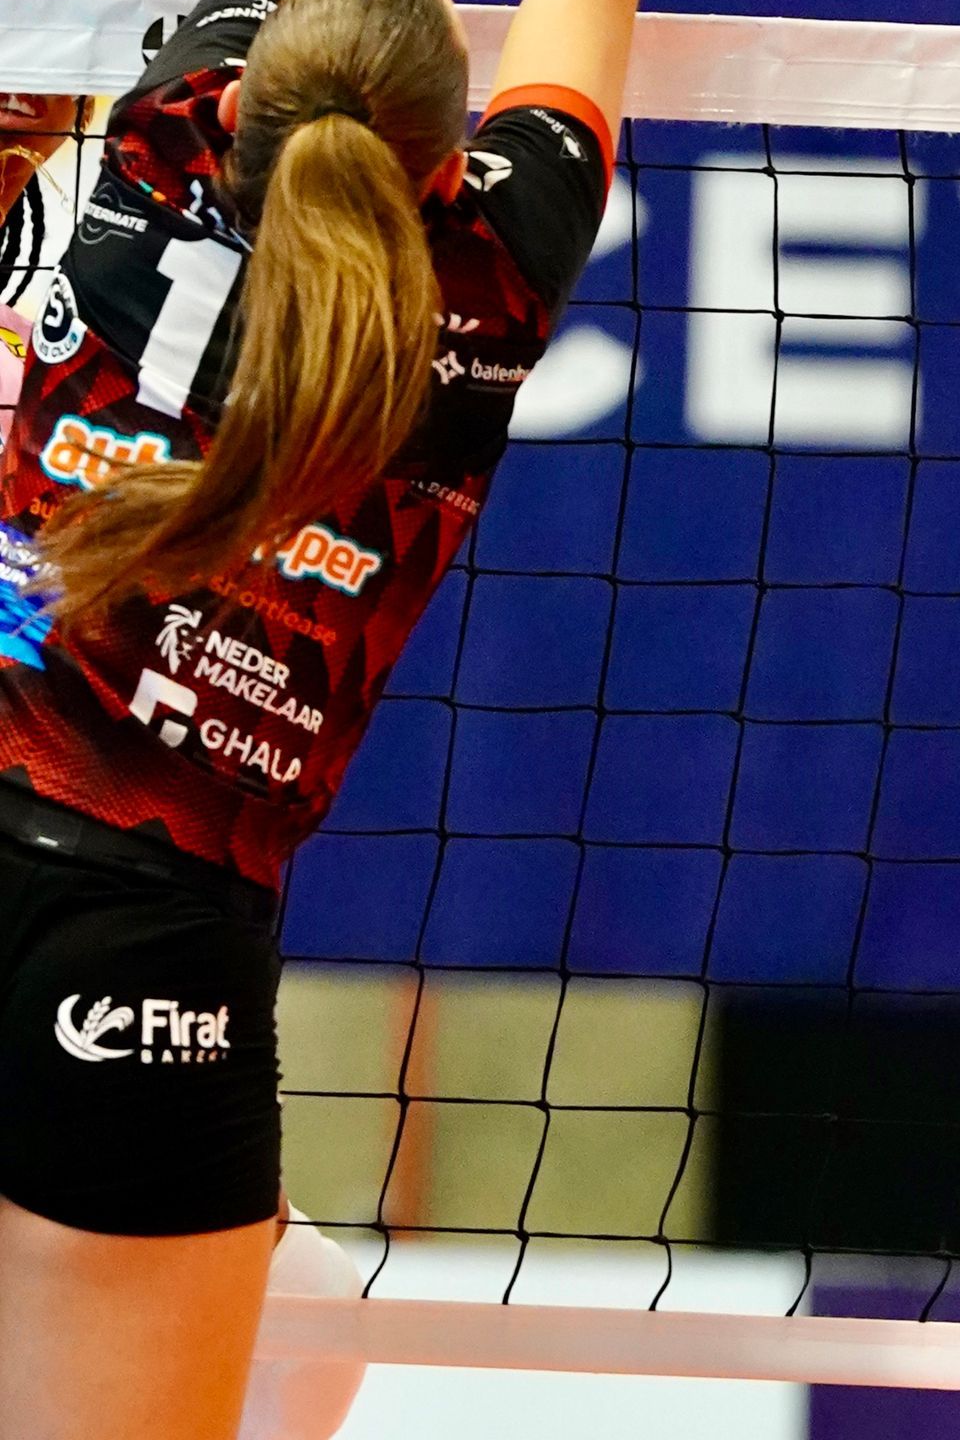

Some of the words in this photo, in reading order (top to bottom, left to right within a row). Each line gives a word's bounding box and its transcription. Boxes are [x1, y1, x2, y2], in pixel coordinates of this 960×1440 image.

[204, 630, 290, 689] NEDER
[194, 656, 324, 735] MAKELAAR
[141, 998, 231, 1049] Firat
